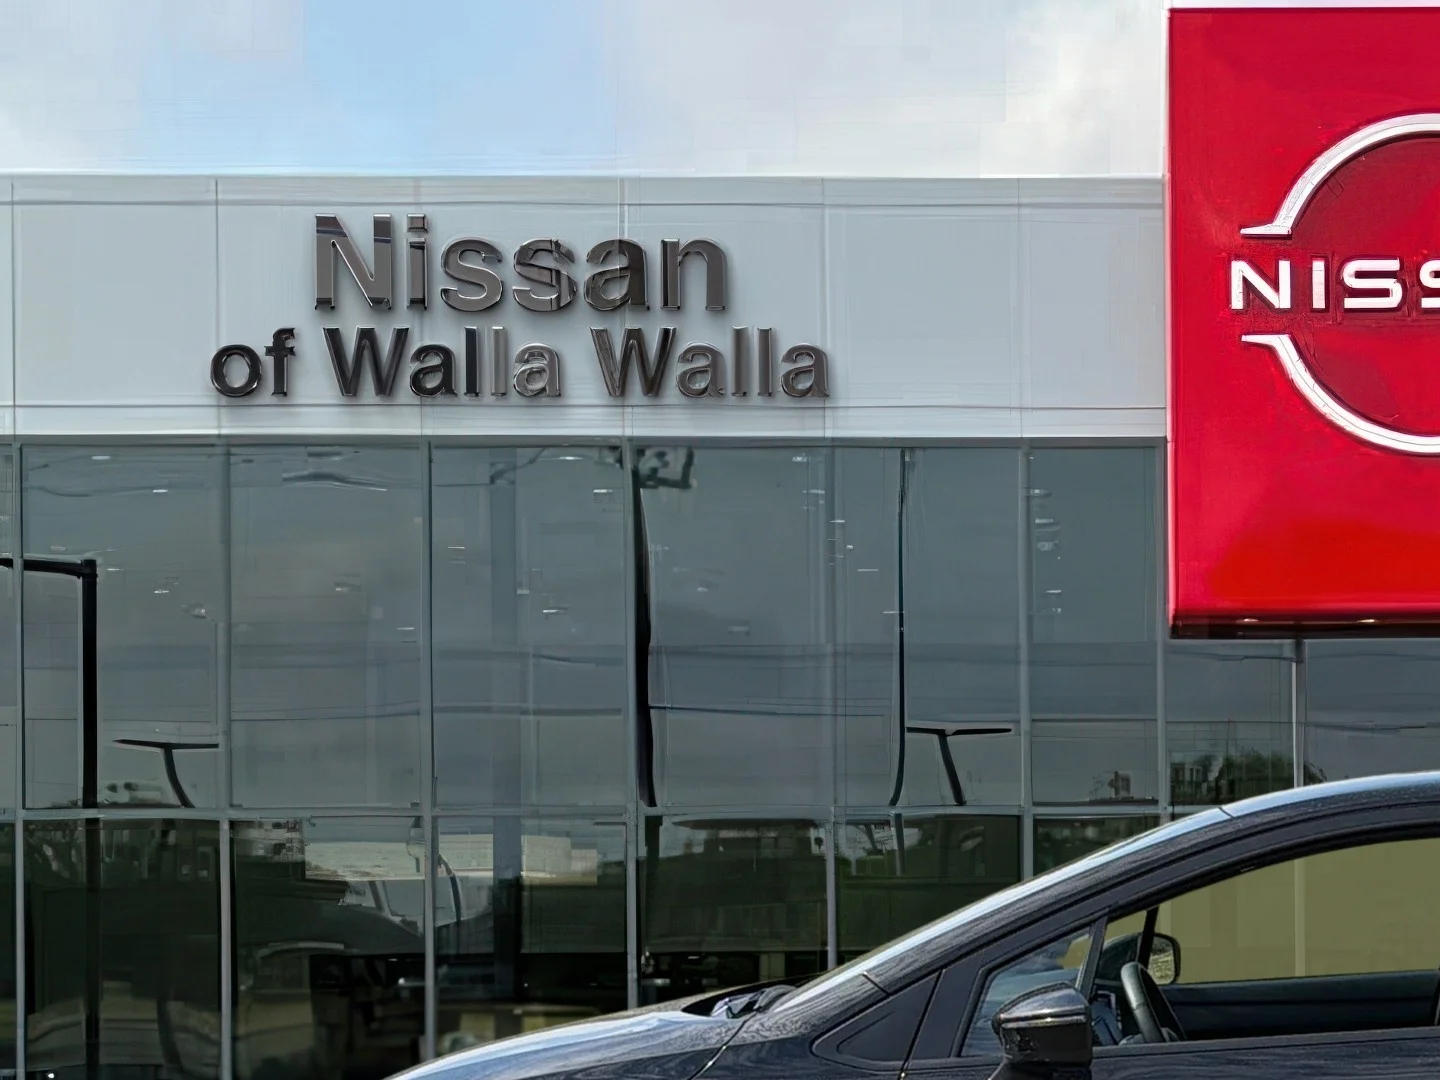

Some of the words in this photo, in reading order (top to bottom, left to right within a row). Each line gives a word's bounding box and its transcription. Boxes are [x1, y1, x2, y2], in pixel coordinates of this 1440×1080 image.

[314, 213, 727, 311] Nissan
[209, 327, 297, 398] of
[321, 326, 562, 398] Walla
[590, 326, 830, 398] Walla
